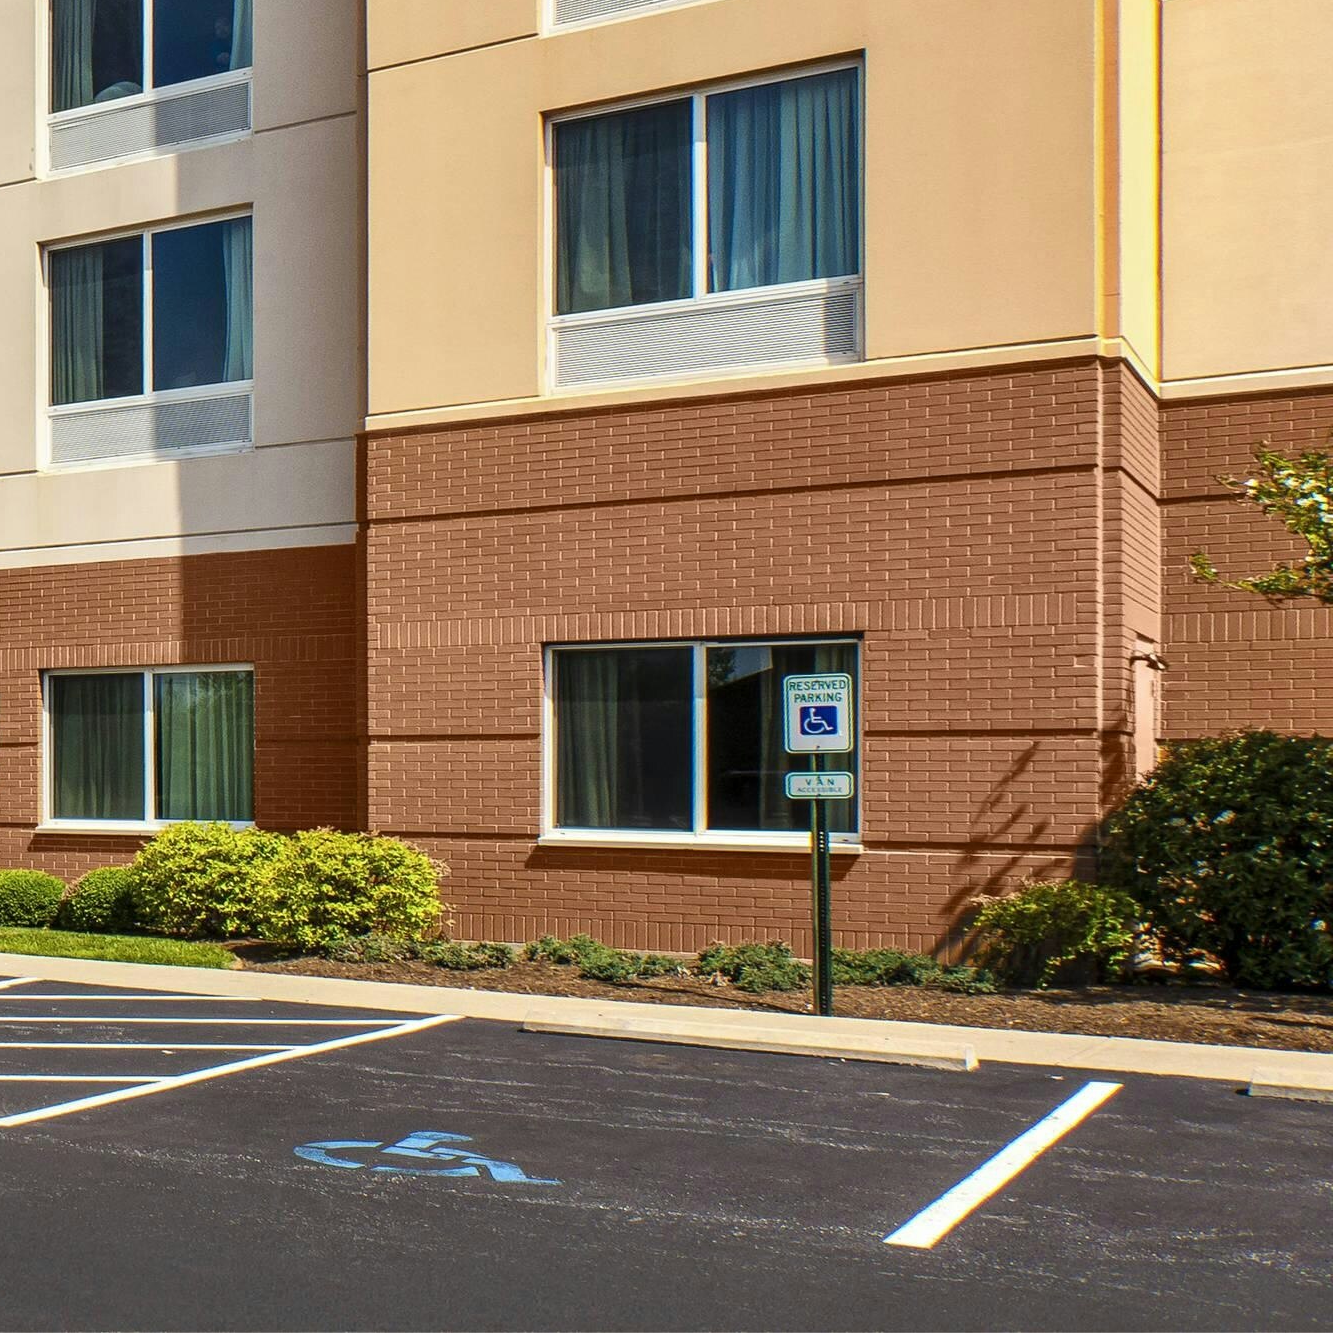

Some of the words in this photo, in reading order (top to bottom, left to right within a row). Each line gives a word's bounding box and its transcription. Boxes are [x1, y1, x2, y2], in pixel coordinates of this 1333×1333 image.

[789, 679, 847, 692] RESERVED
[794, 692, 843, 703] PARKING
[805, 778, 835, 786] VAN
